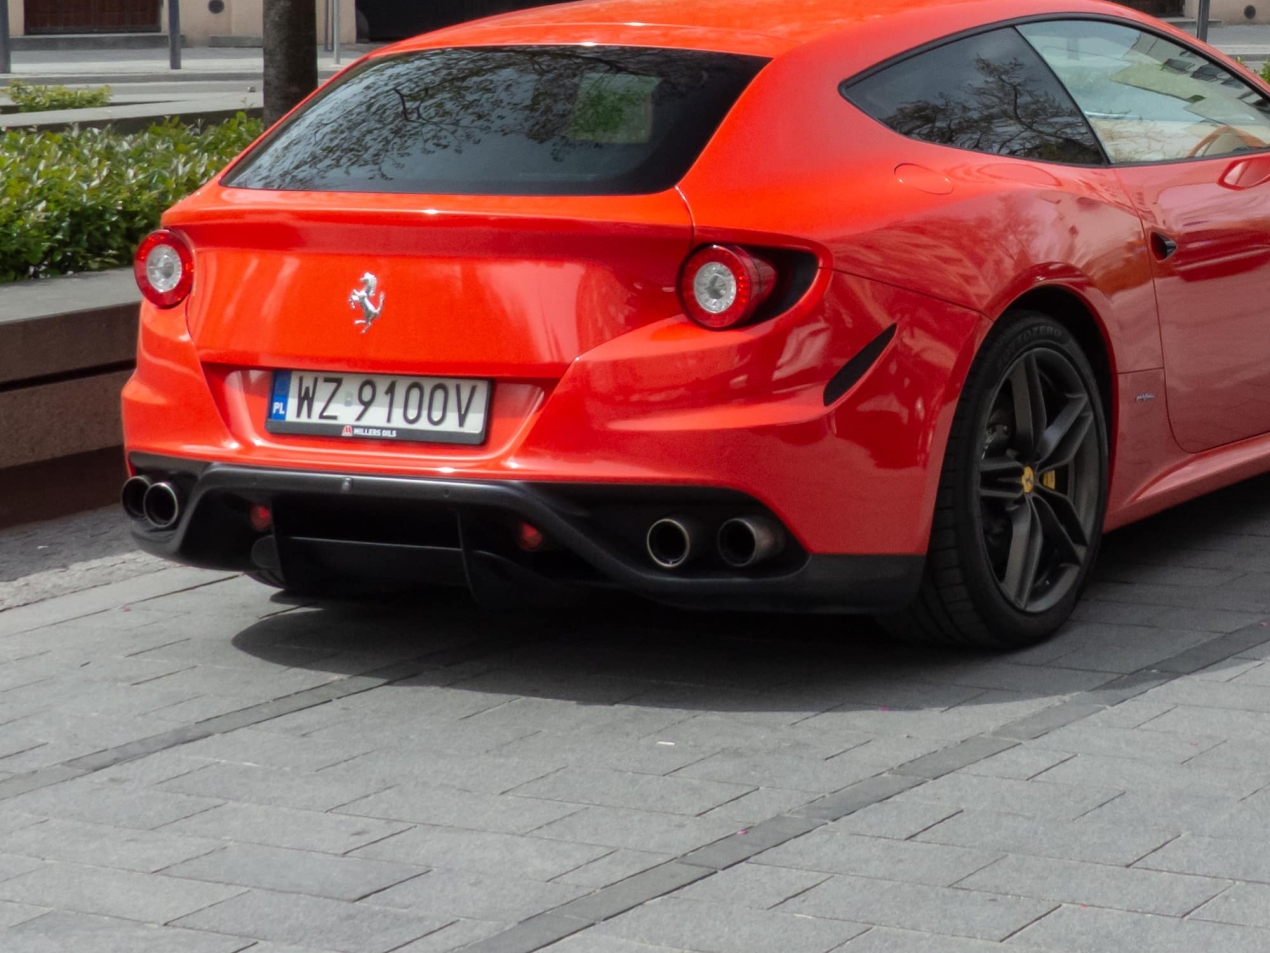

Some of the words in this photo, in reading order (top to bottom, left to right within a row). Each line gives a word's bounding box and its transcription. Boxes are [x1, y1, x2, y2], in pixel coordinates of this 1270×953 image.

[272, 401, 285, 416] PL
[296, 375, 343, 421] WZ
[355, 378, 477, 428] 9100V
[353, 428, 381, 437] MILLERS
[382, 429, 397, 438] OILS
